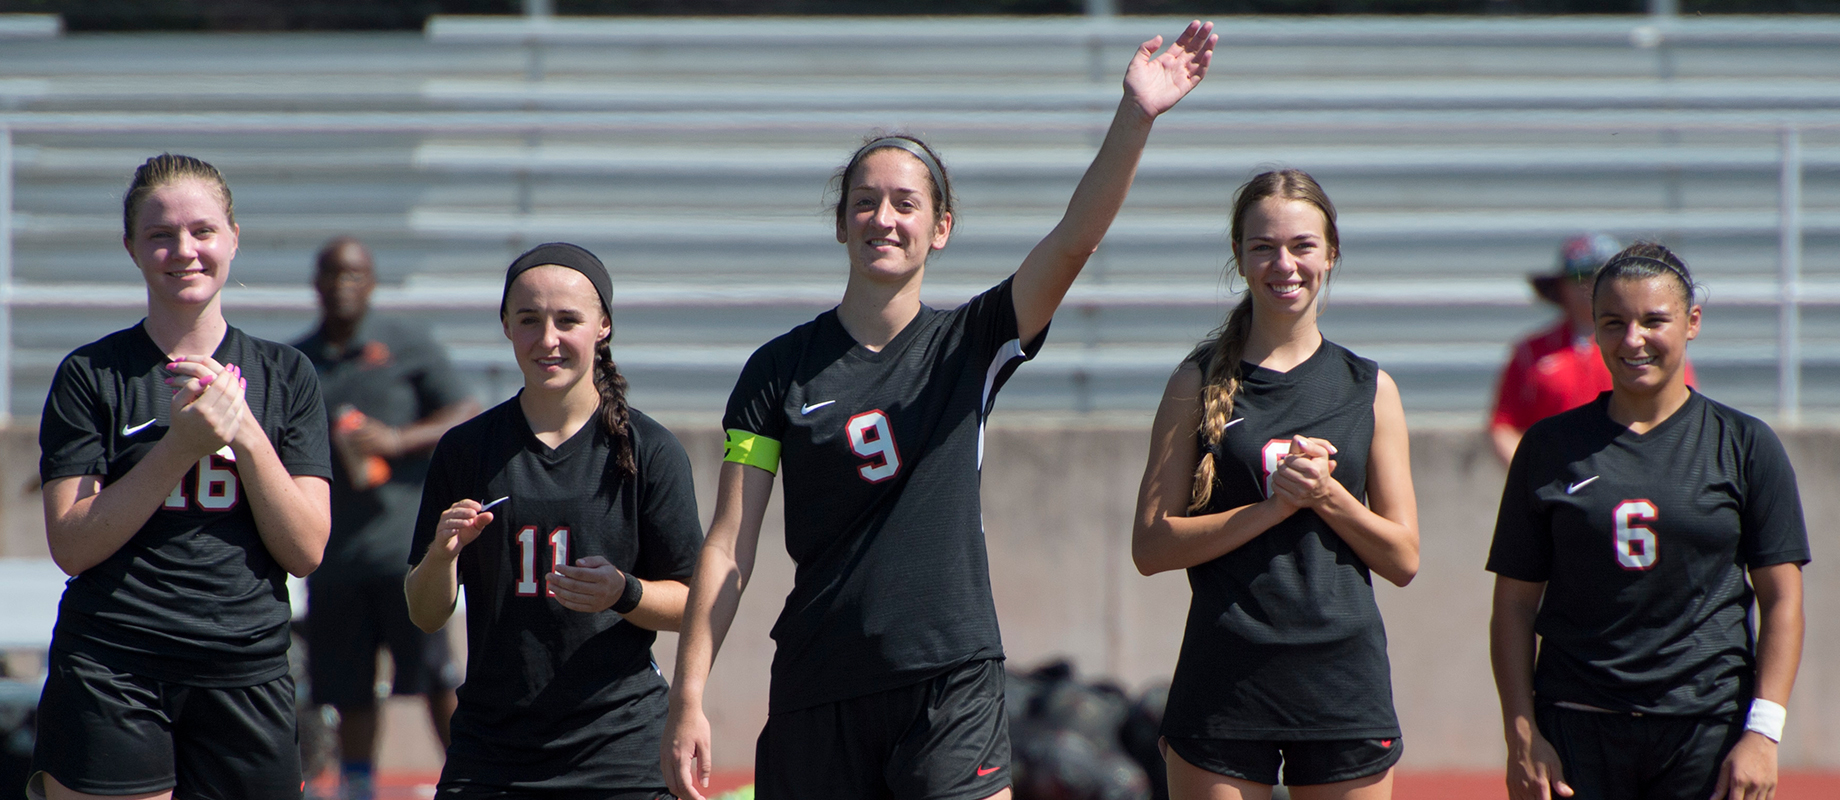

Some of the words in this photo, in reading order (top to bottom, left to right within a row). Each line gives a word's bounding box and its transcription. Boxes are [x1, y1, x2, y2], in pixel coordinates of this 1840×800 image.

[844, 408, 903, 484] 9
[515, 525, 570, 597] 11
[1612, 498, 1659, 571] 6
